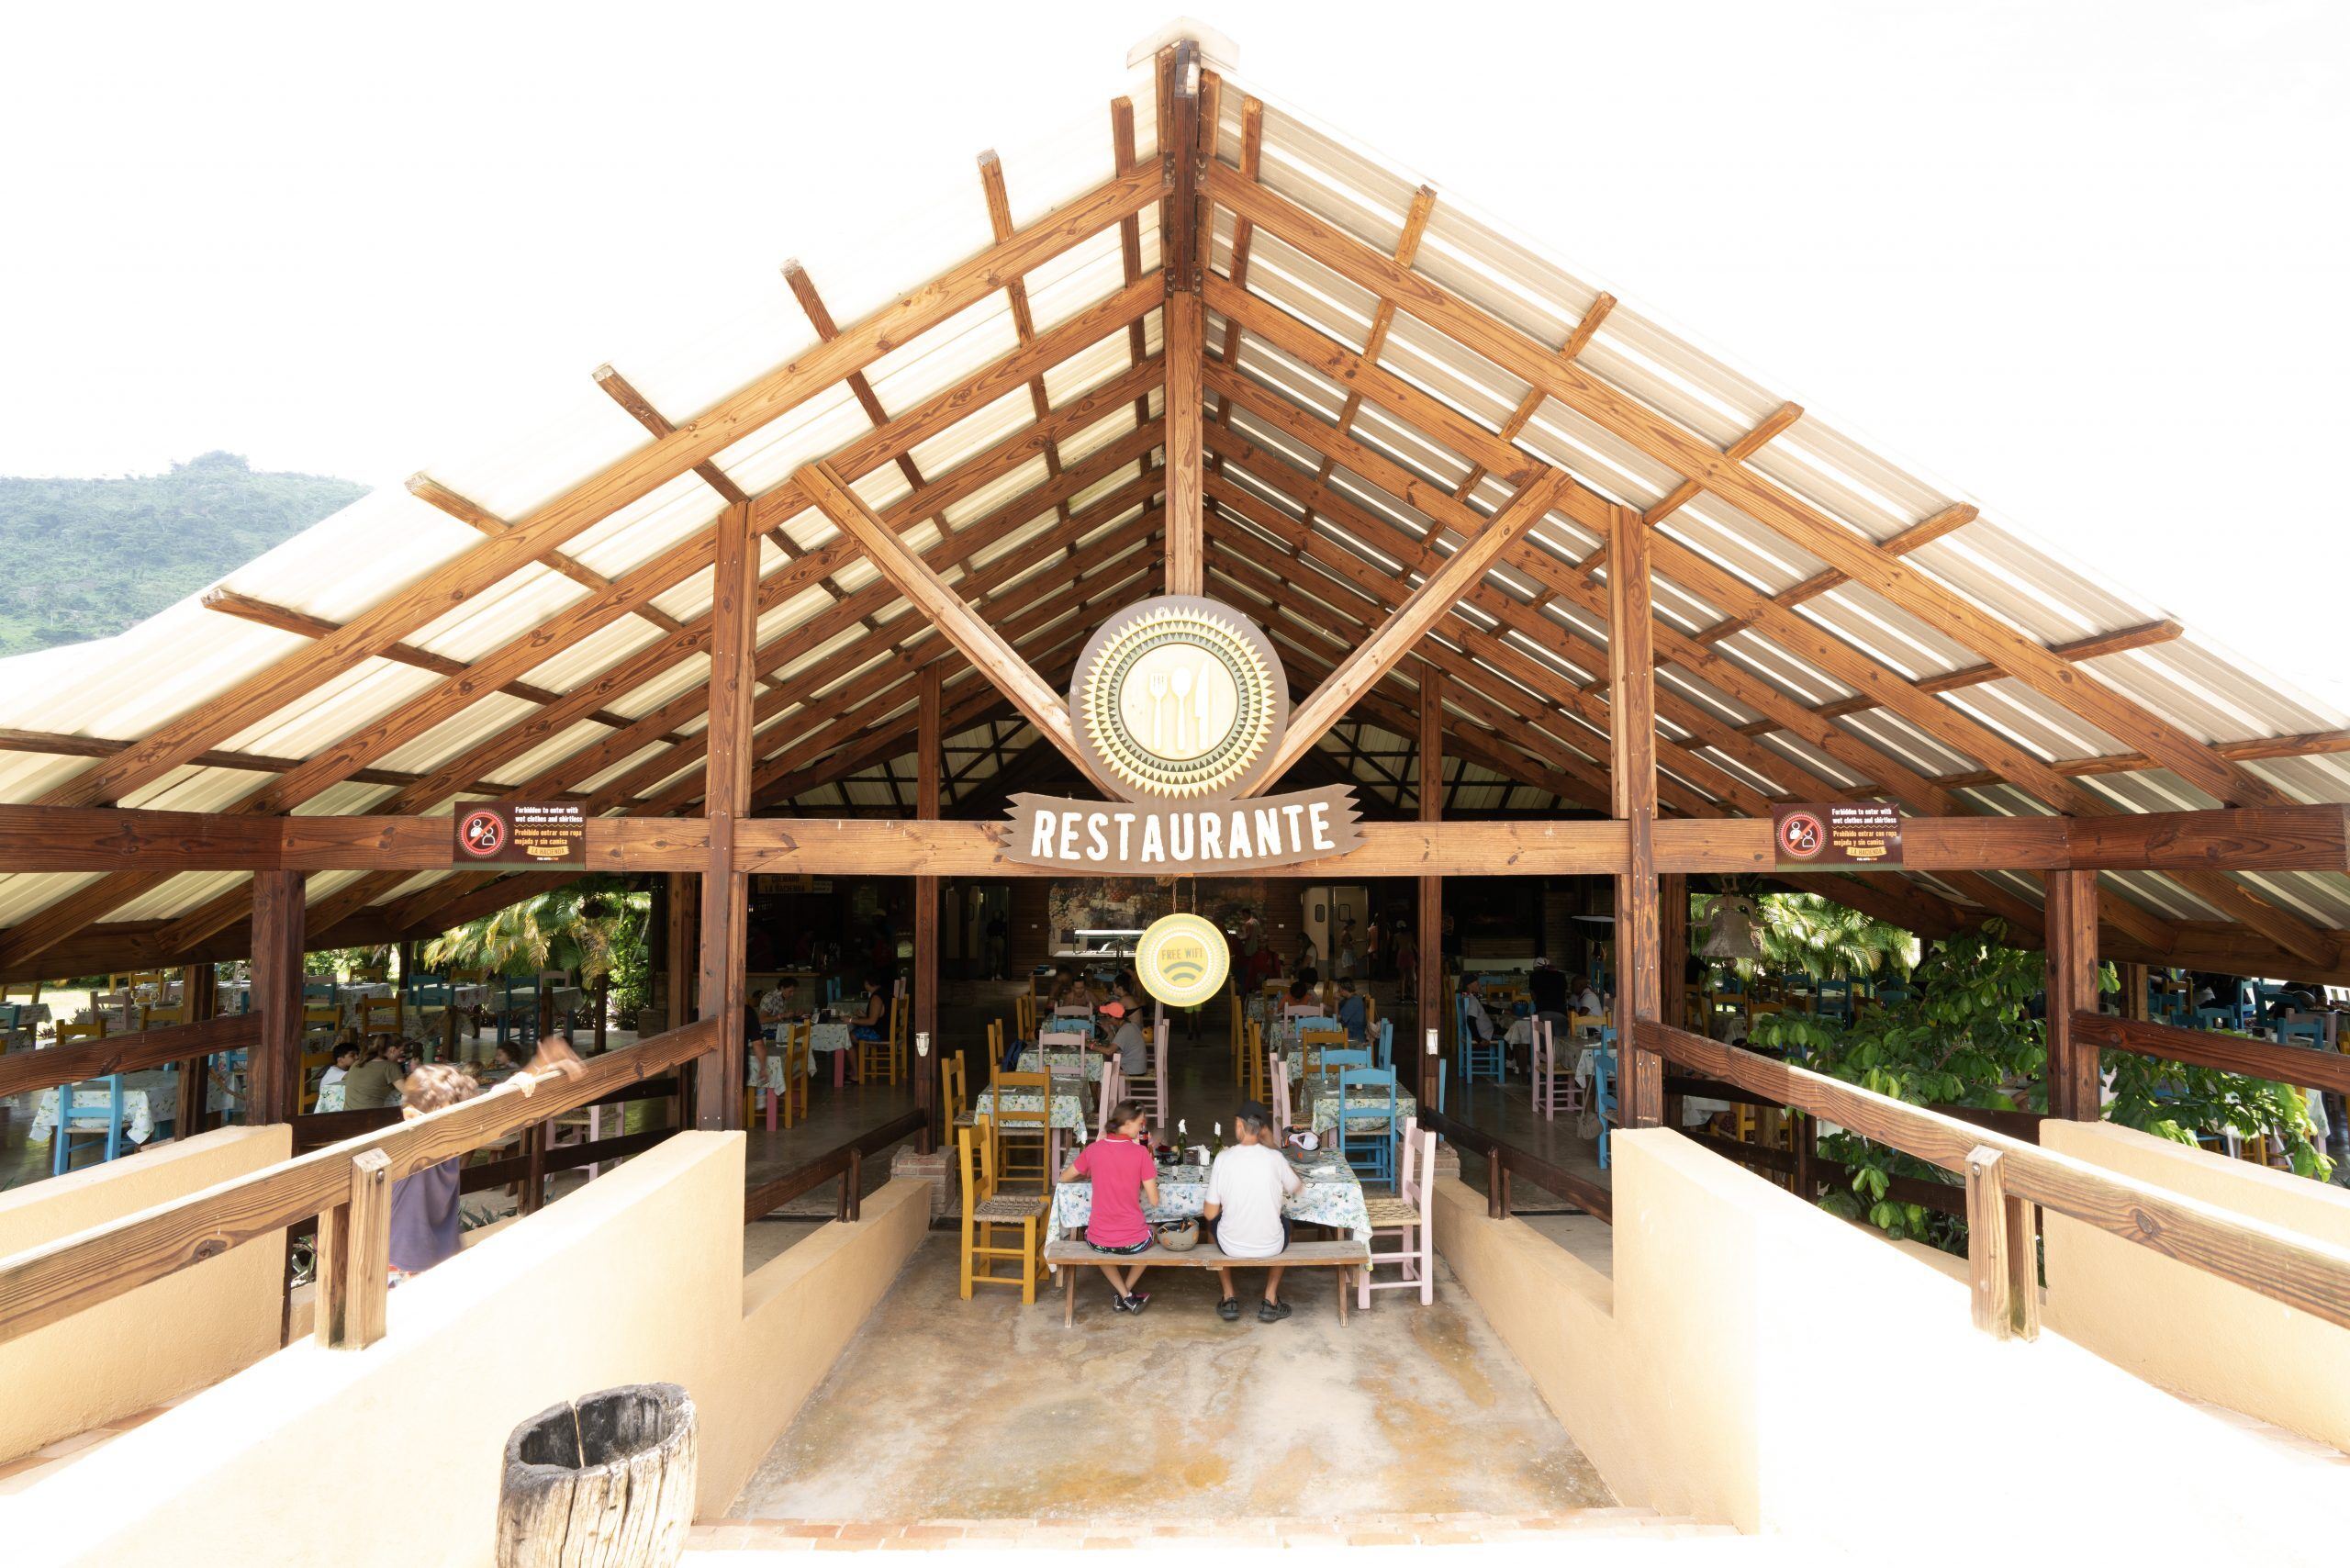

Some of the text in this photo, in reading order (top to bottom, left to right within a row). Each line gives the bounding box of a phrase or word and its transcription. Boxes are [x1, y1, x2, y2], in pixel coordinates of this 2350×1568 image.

[1032, 802, 1336, 863] RESTAURANTE
[1161, 947, 1203, 960] FREE WIFI
